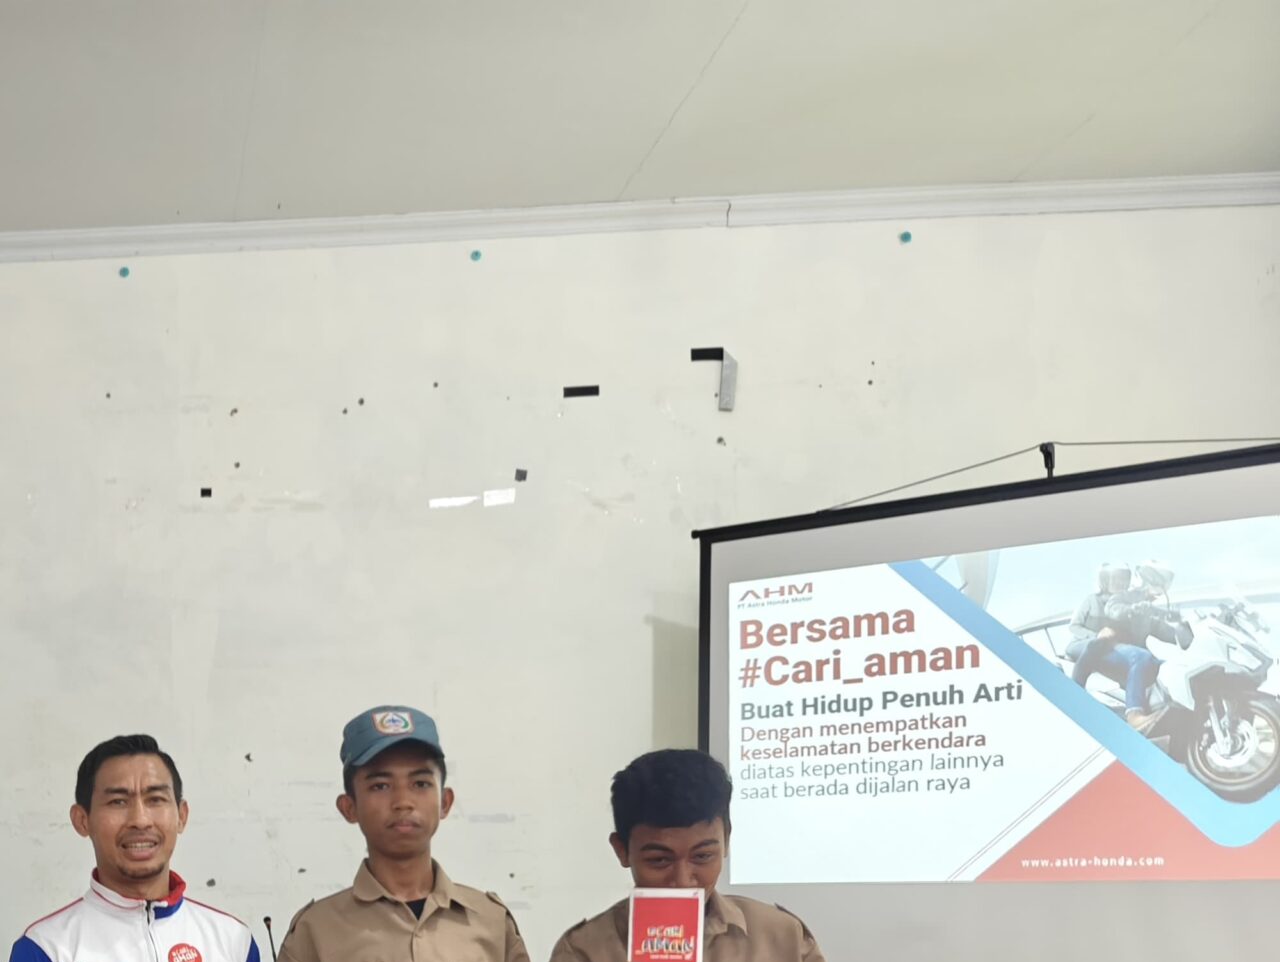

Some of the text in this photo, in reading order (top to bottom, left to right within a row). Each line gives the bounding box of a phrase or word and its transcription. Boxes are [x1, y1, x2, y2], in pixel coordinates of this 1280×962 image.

[738, 582, 814, 601] AHM
[739, 608, 916, 650] Bersama
[738, 643, 981, 689] #Cari_aman
[740, 679, 1023, 721] Buat Hidup Penuh Arti
[740, 712, 968, 744] Dengan menempatkan
[739, 731, 987, 761] keselamatan berkendara
[739, 752, 1005, 781] diatas kepentingan lainnya
[740, 776, 972, 800] saat berada dijalan raya
[1020, 855, 1165, 868] www.astra-honda.com
